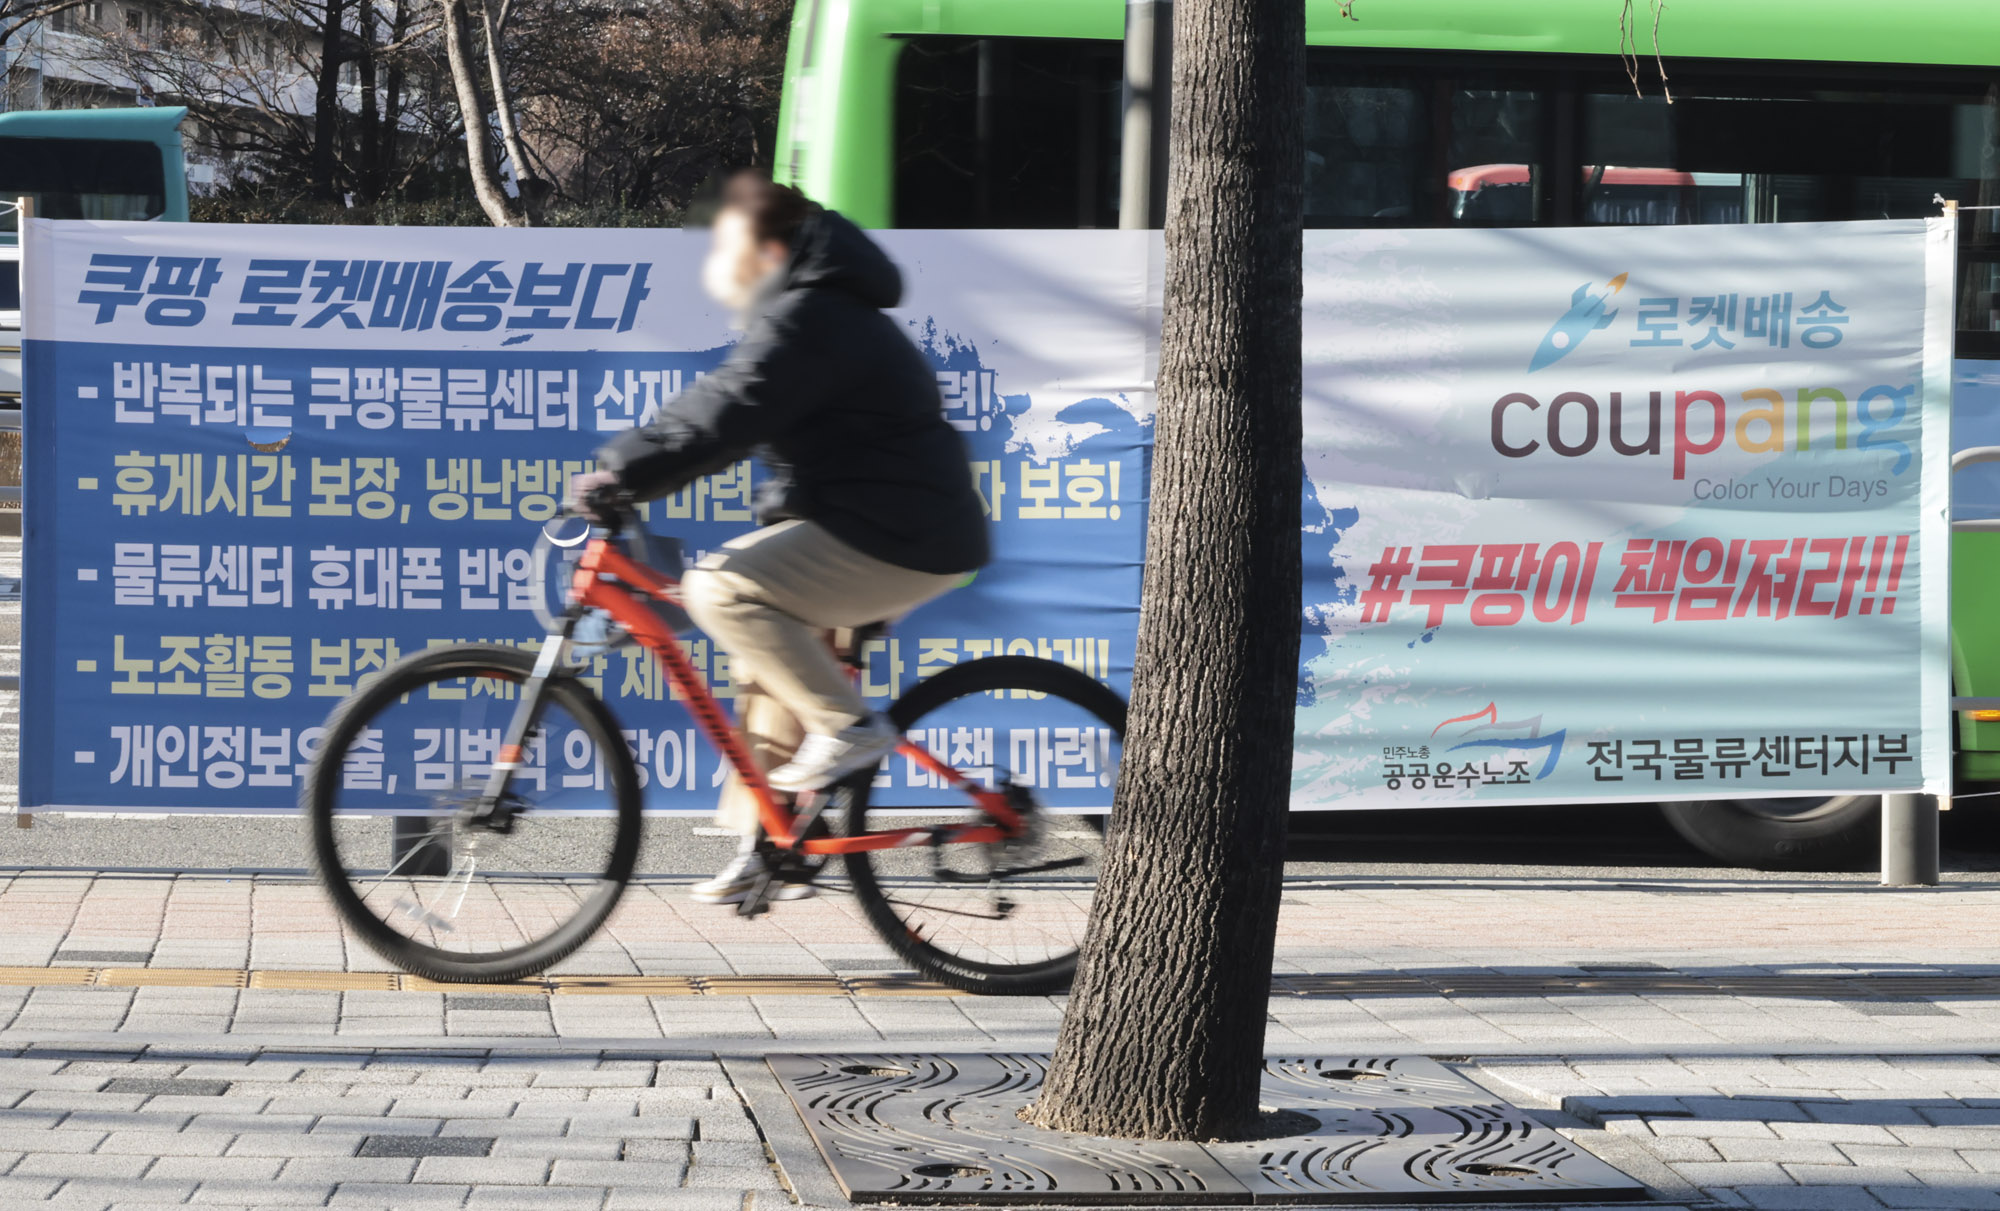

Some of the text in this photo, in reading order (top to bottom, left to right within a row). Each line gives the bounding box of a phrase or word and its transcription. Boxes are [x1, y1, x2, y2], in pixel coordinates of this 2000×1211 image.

[77, 253, 653, 334] 쿠팡 로켓배송보다
[1629, 290, 1850, 351] 로켓배송
[113, 361, 295, 429] 반복되는
[308, 367, 578, 432] 쿠팡물류센터
[1490, 384, 1916, 480] coupang
[113, 450, 297, 518] 휴게시간
[310, 457, 411, 525] 보장,
[1018, 458, 1122, 522] 보호!
[1693, 475, 1888, 503] Color Your Days
[112, 542, 294, 608] 물류센터
[308, 545, 443, 611] 휴대폰
[458, 547, 546, 610] 반입
[1359, 535, 1910, 630] #쿠팡이 책임져라!!
[112, 633, 294, 699] 노조활동
[906, 726, 995, 790] 대책
[1009, 726, 1111, 789] 마련!
[1382, 745, 1431, 760] 민주노총
[1382, 760, 1532, 791] 공공운수노조
[1586, 733, 1913, 782] 전국물류센터지부
